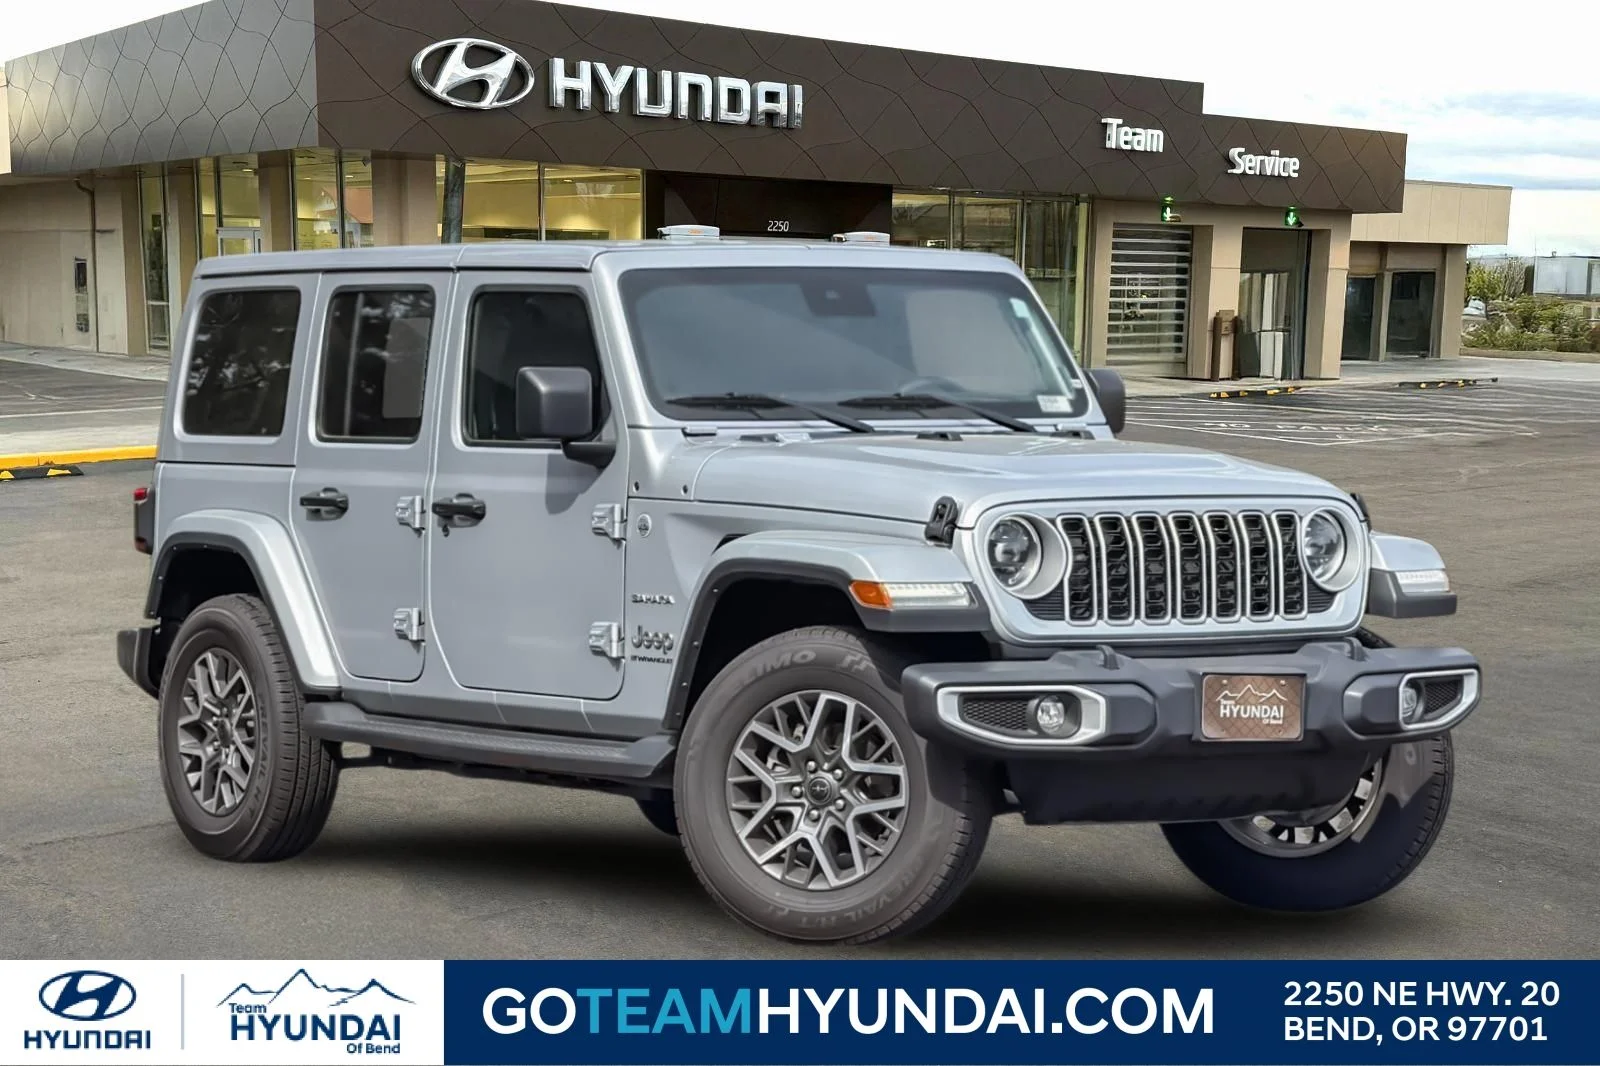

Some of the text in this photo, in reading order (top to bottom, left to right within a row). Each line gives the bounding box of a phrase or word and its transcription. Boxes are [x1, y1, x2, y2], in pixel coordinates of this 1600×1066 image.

[549, 57, 803, 129] HYUNDAI
[1101, 117, 1164, 152] Team
[1227, 147, 1300, 177] Service
[767, 220, 790, 232] 2250
[632, 625, 674, 655] Jeep
[1220, 705, 1284, 718] HYUNDAI
